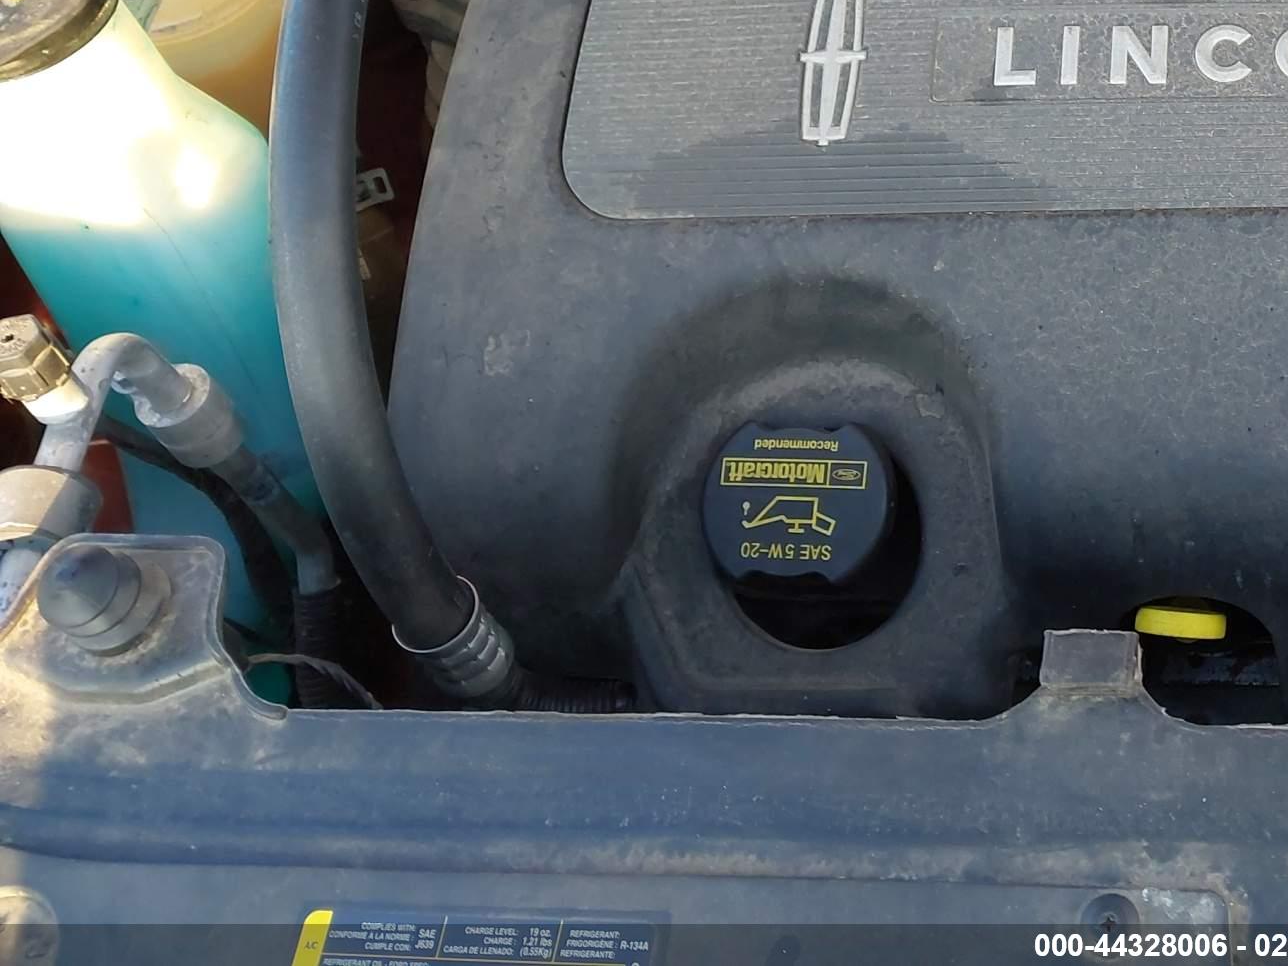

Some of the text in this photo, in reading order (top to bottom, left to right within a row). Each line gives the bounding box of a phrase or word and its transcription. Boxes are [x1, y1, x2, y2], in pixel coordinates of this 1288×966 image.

[754, 439, 839, 452] Recommended
[728, 462, 825, 484] Motorcraft
[740, 542, 832, 560] SAE 5W-20
[418, 929, 437, 939] SAE
[465, 926, 494, 935] CHARGE
[530, 928, 540, 937] 19
[414, 940, 434, 950] J639
[484, 937, 513, 946] CHARGE
[523, 936, 538, 946] 1.21
[620, 940, 649, 951] R-134A
[444, 946, 468, 954] CARGA
